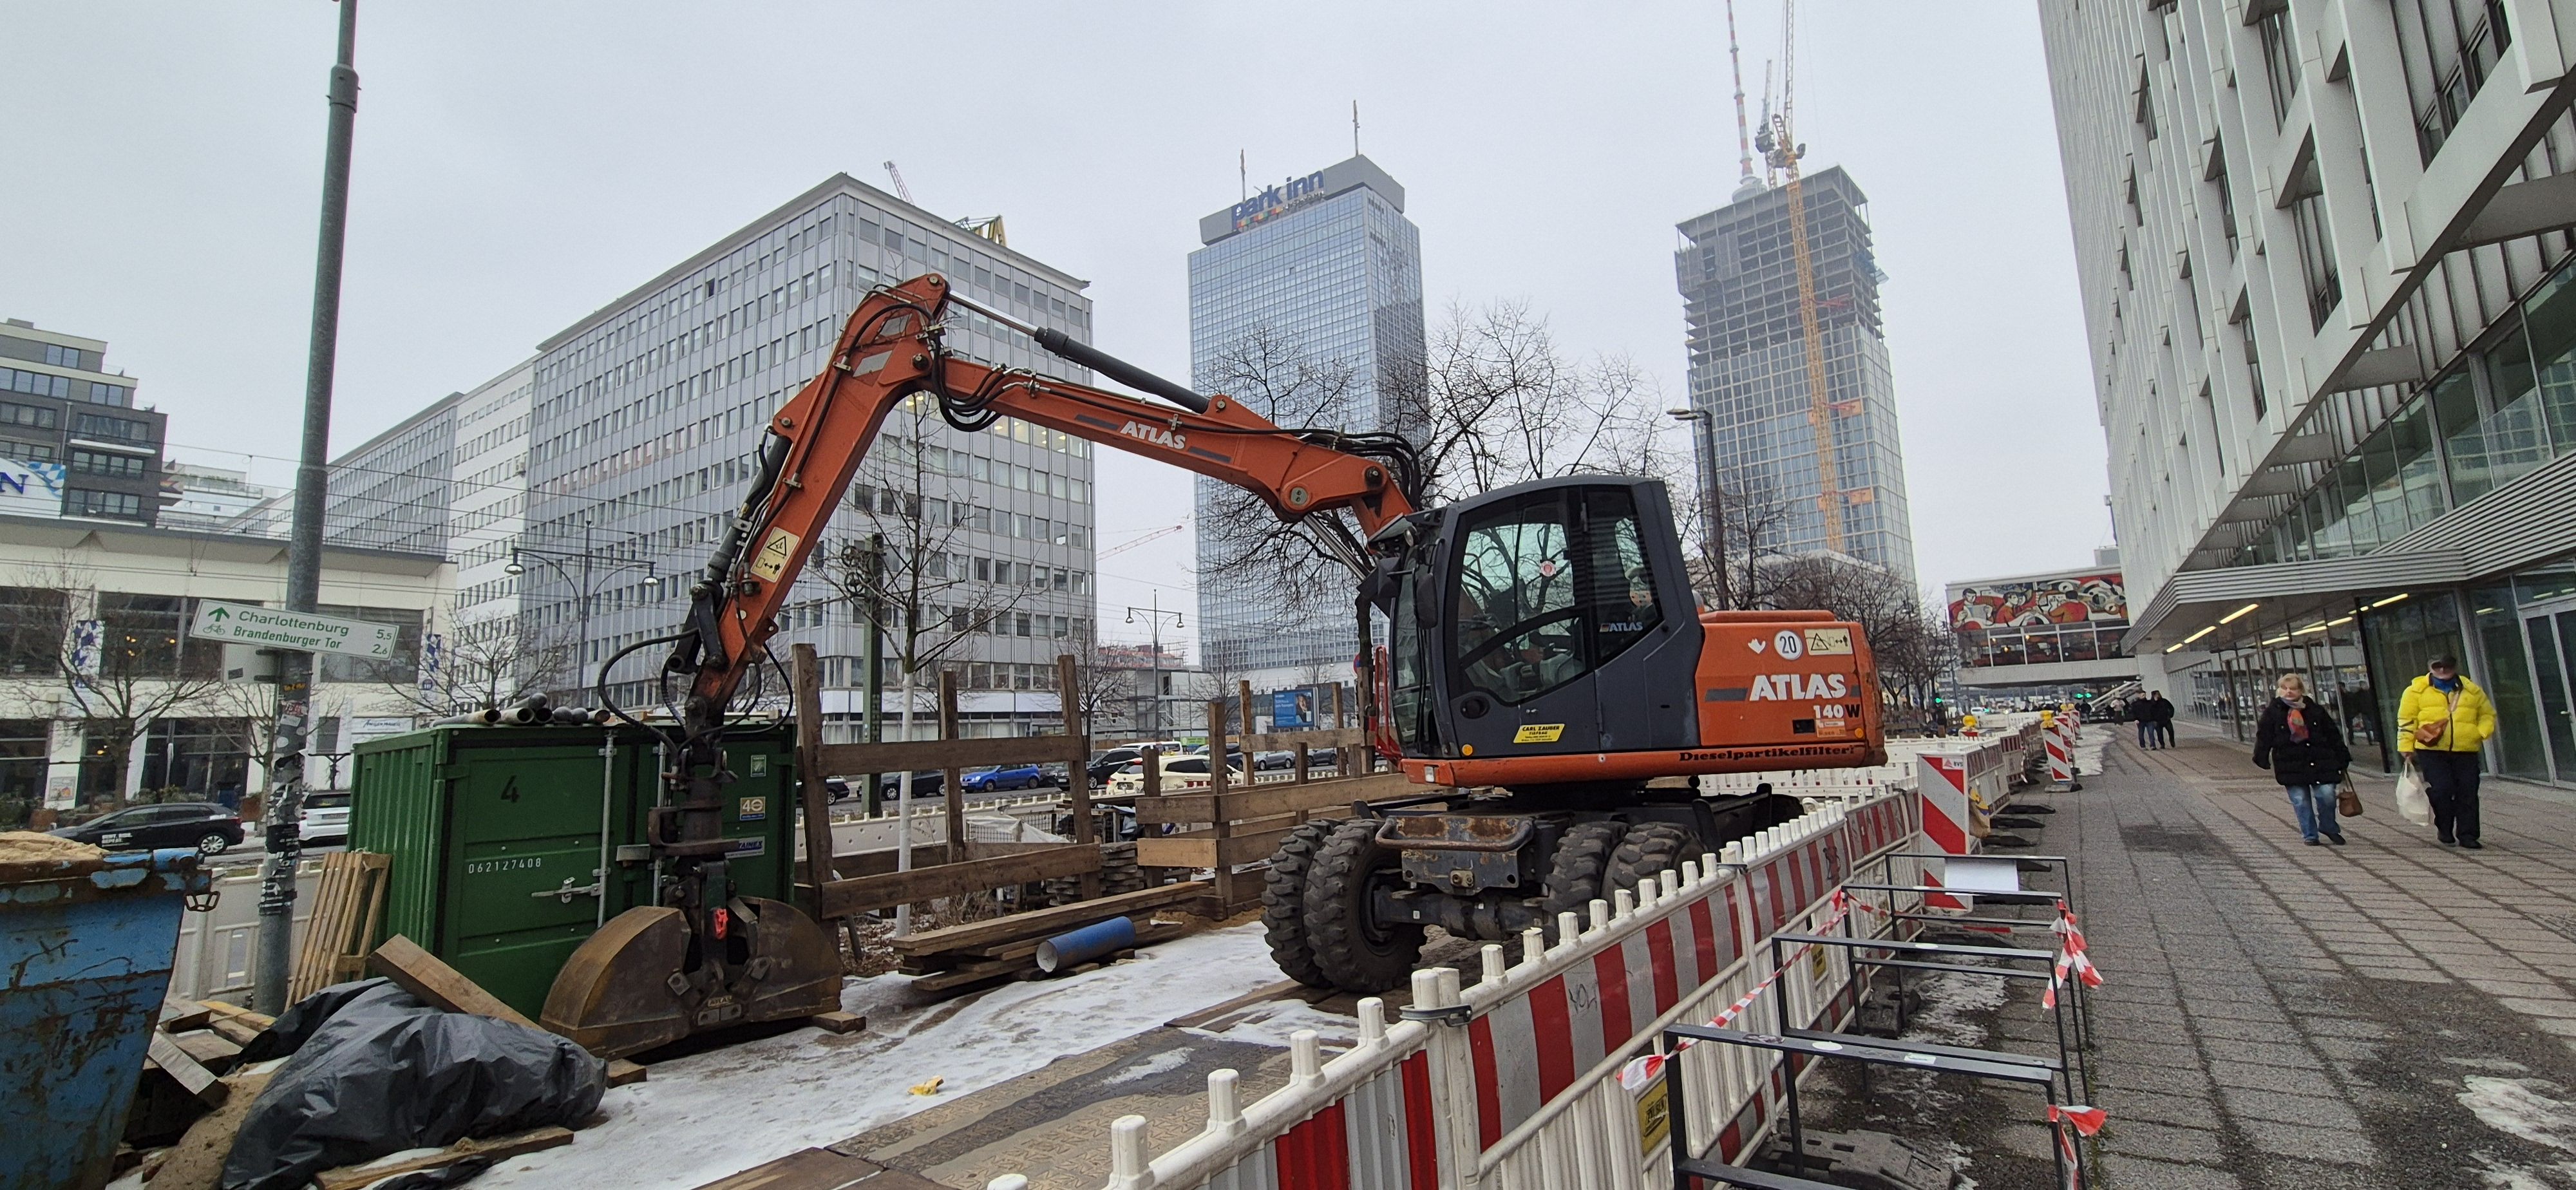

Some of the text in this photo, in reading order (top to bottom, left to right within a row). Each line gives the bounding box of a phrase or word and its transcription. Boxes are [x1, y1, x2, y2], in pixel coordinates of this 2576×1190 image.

[1231, 184, 1283, 231] park
[1286, 170, 1324, 201] inn
[1120, 420, 1186, 449] ATLAS
[238, 610, 350, 636] Charlottenburg
[1610, 622, 1643, 632] ATLAS
[233, 626, 321, 647] Brandenburger
[325, 639, 342, 649] Tor
[1779, 636, 1797, 654] 20
[1749, 674, 1846, 701] ATLAS
[500, 775, 520, 803] 4
[468, 858, 541, 874] 062127408
